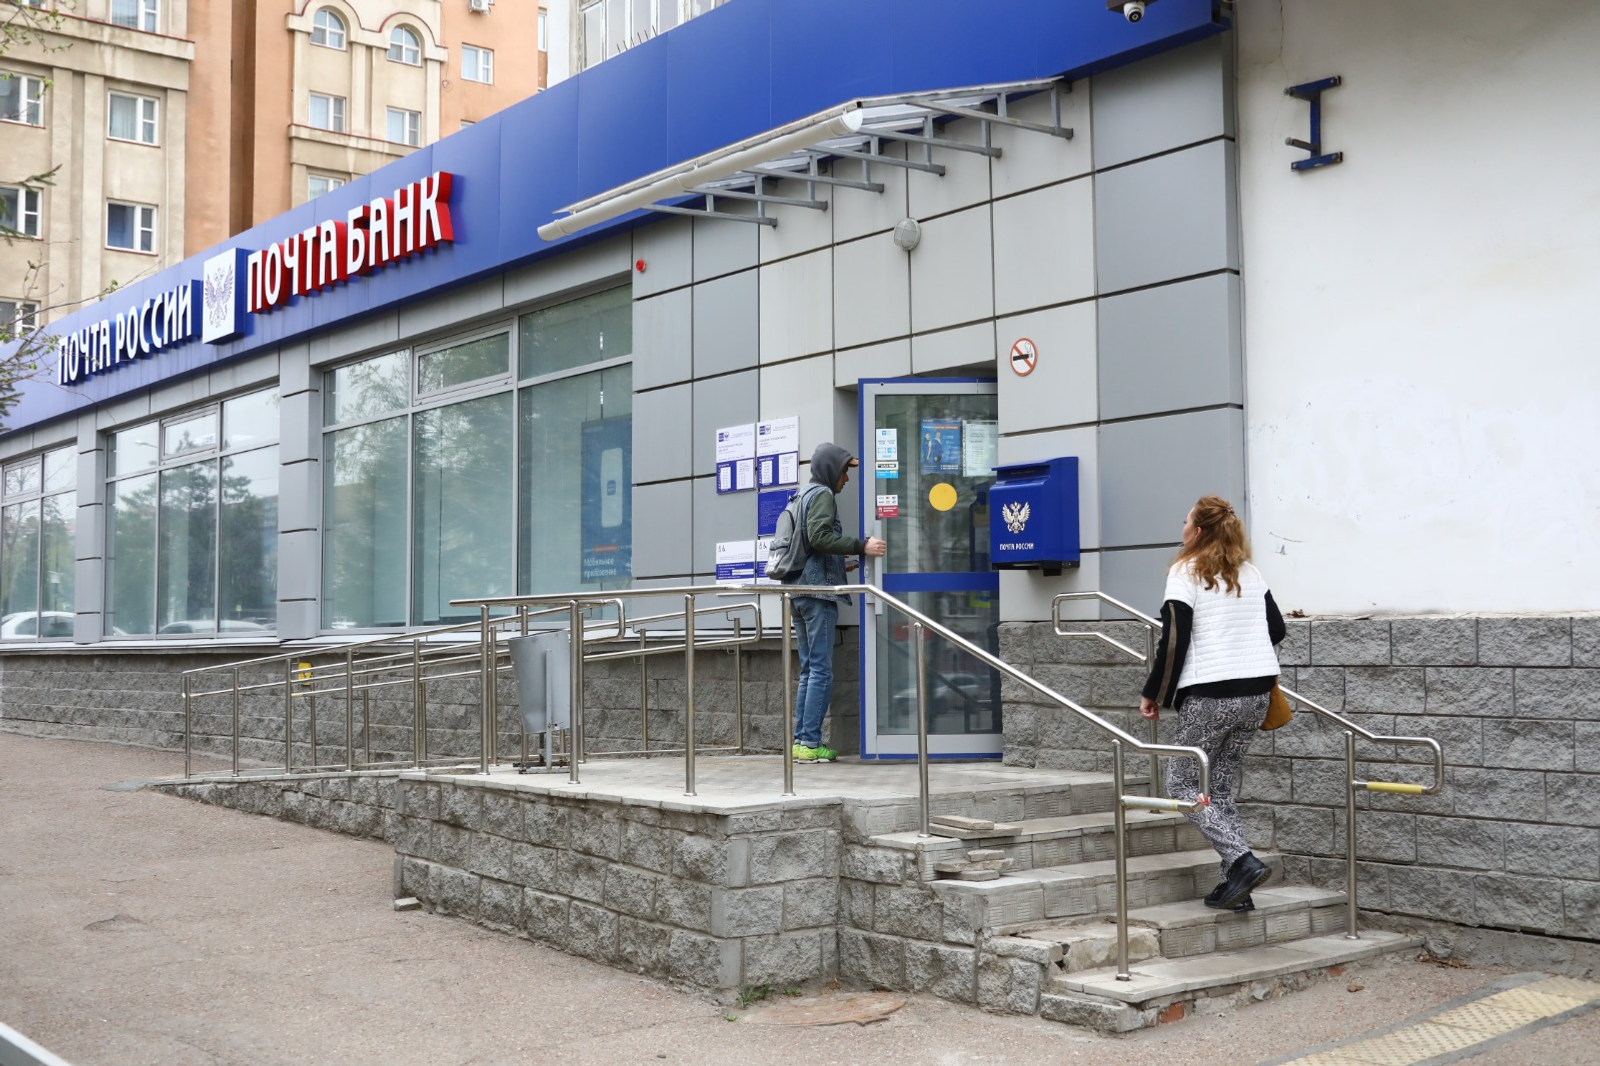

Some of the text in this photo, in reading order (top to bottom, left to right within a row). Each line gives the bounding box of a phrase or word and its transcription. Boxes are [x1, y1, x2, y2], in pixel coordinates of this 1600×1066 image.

[247, 171, 448, 313] ПОЧТА БАНК
[57, 279, 192, 386] ПОЧТА РОССИИ
[1000, 542, 1034, 551] ПОЧТА РОССИИ
